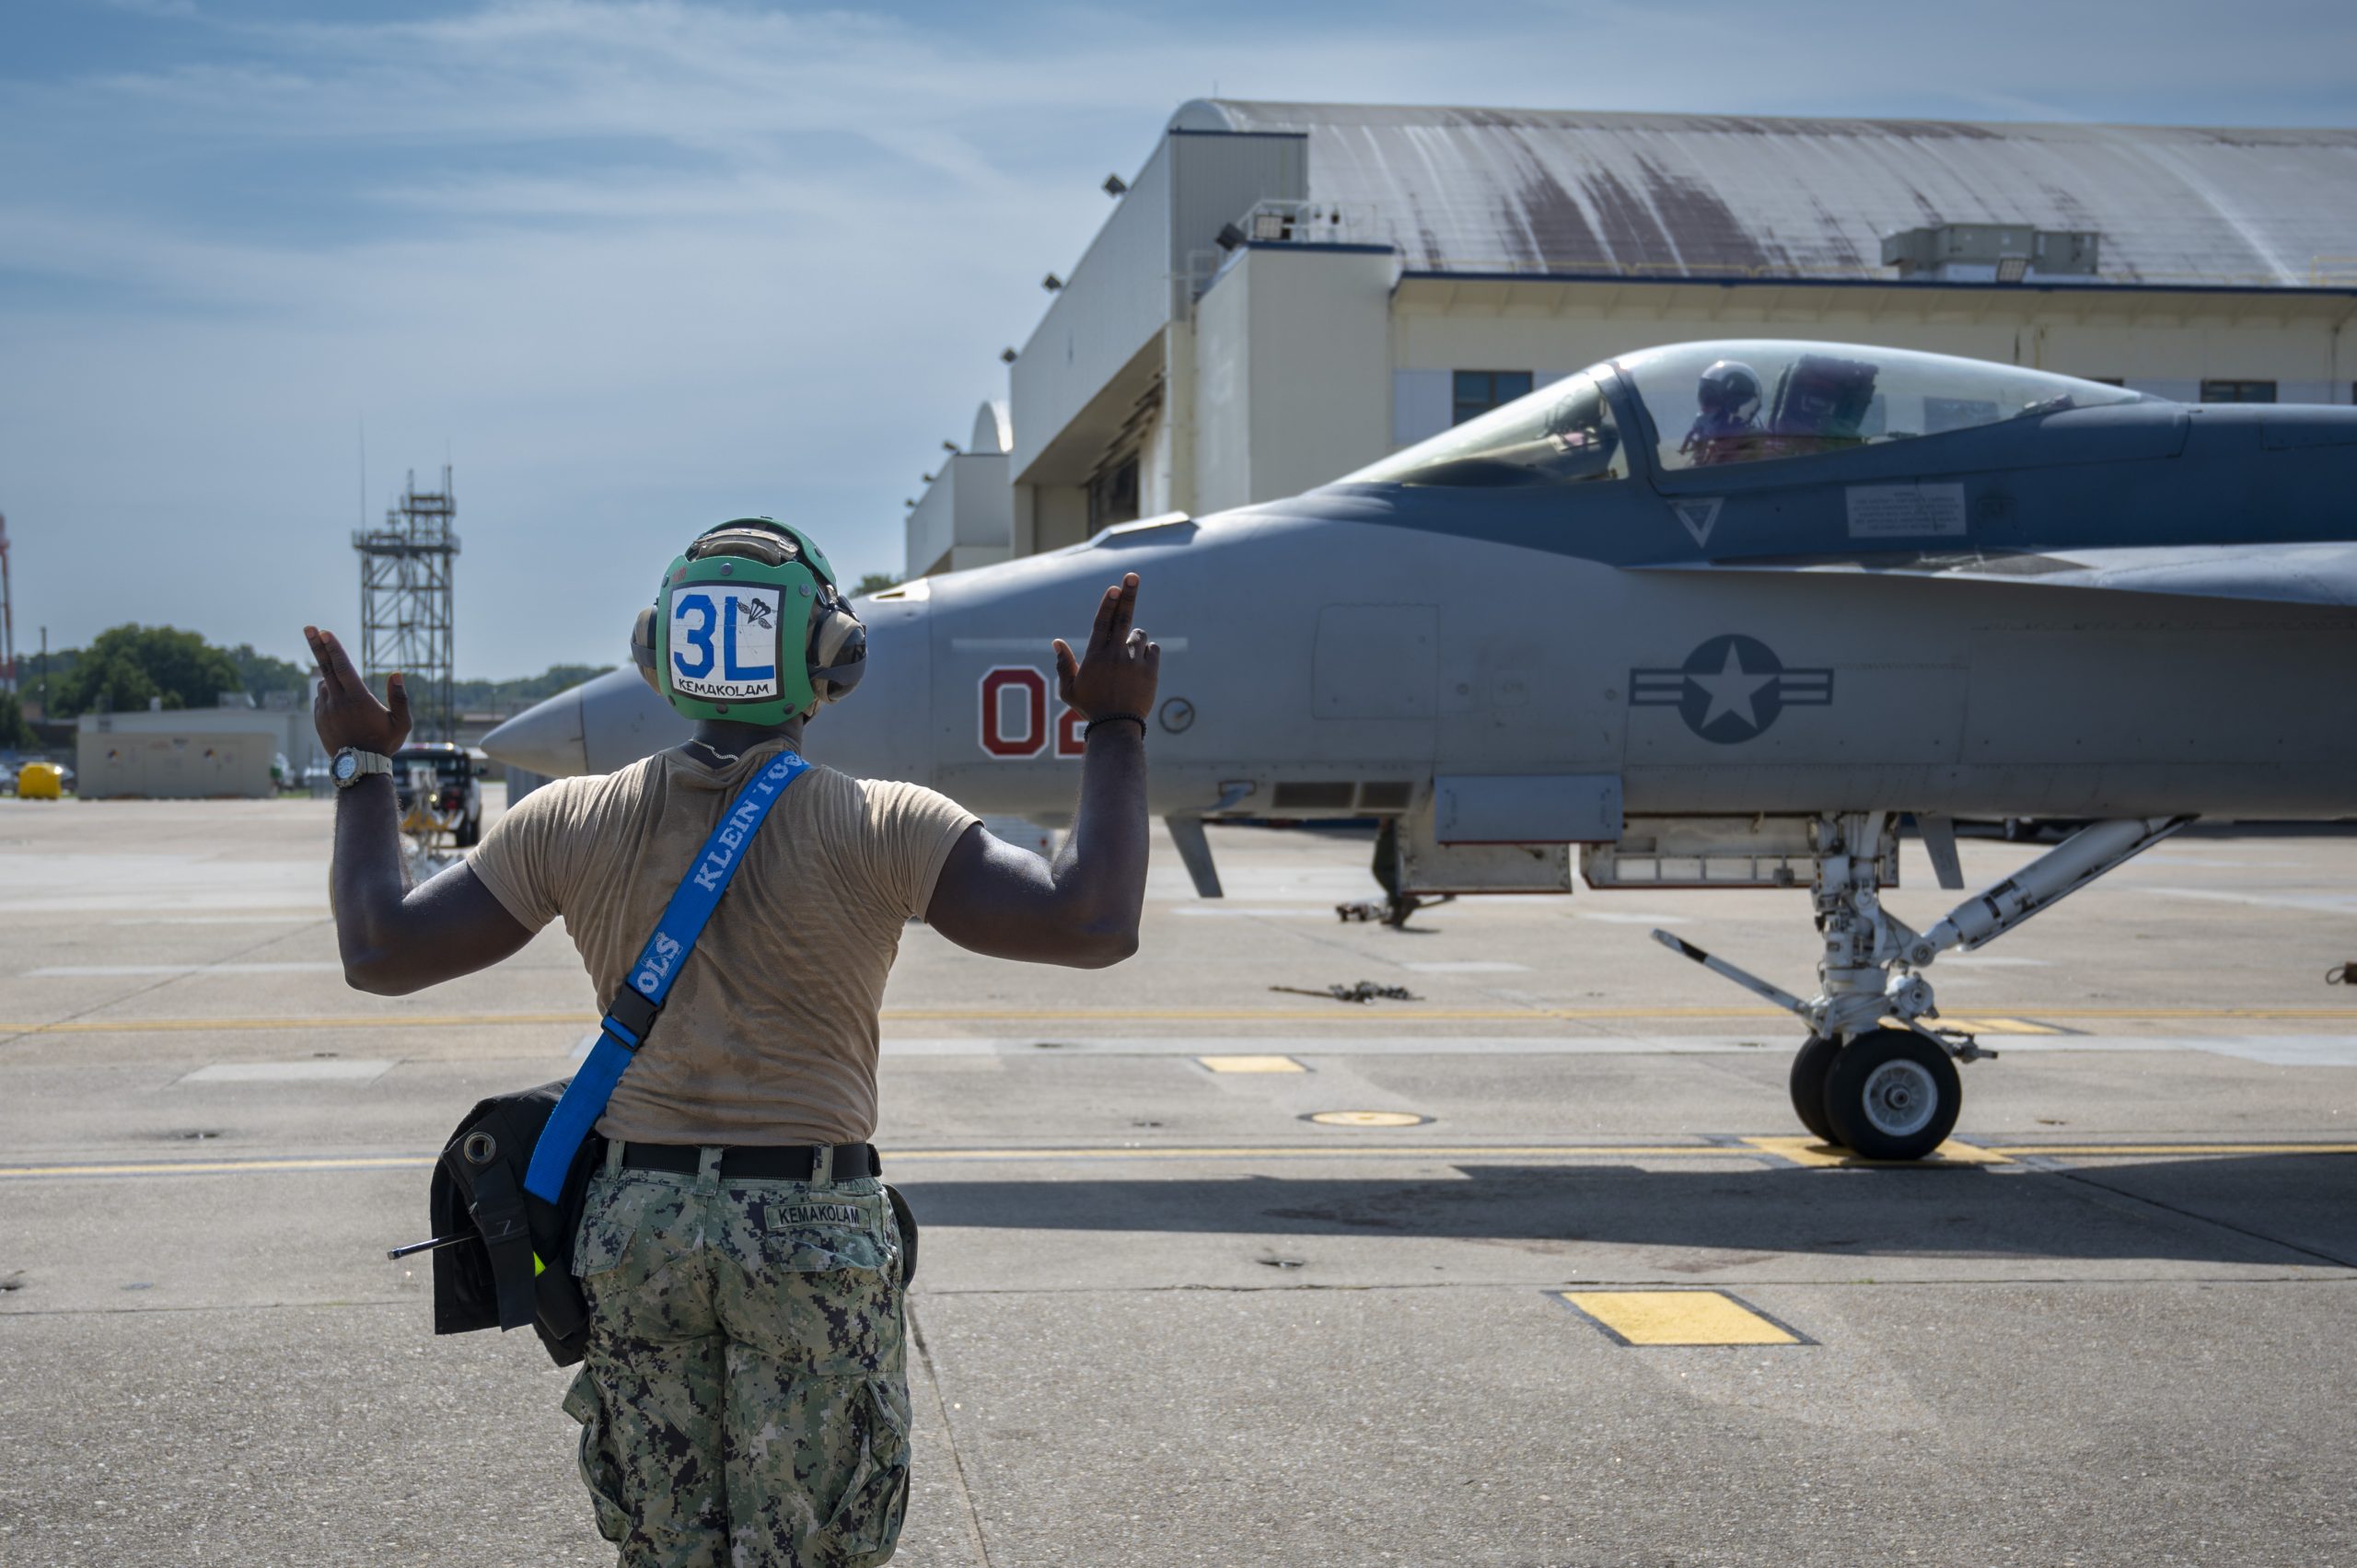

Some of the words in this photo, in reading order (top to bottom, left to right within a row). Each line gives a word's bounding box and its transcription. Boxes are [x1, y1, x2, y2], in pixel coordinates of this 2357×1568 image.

[673, 594, 775, 681] 3L
[679, 679, 770, 697] KEMAKOLAM
[693, 799, 761, 892] KLEIN
[637, 932, 680, 993] OLS
[779, 1206, 860, 1225] KEMAKOLAM
